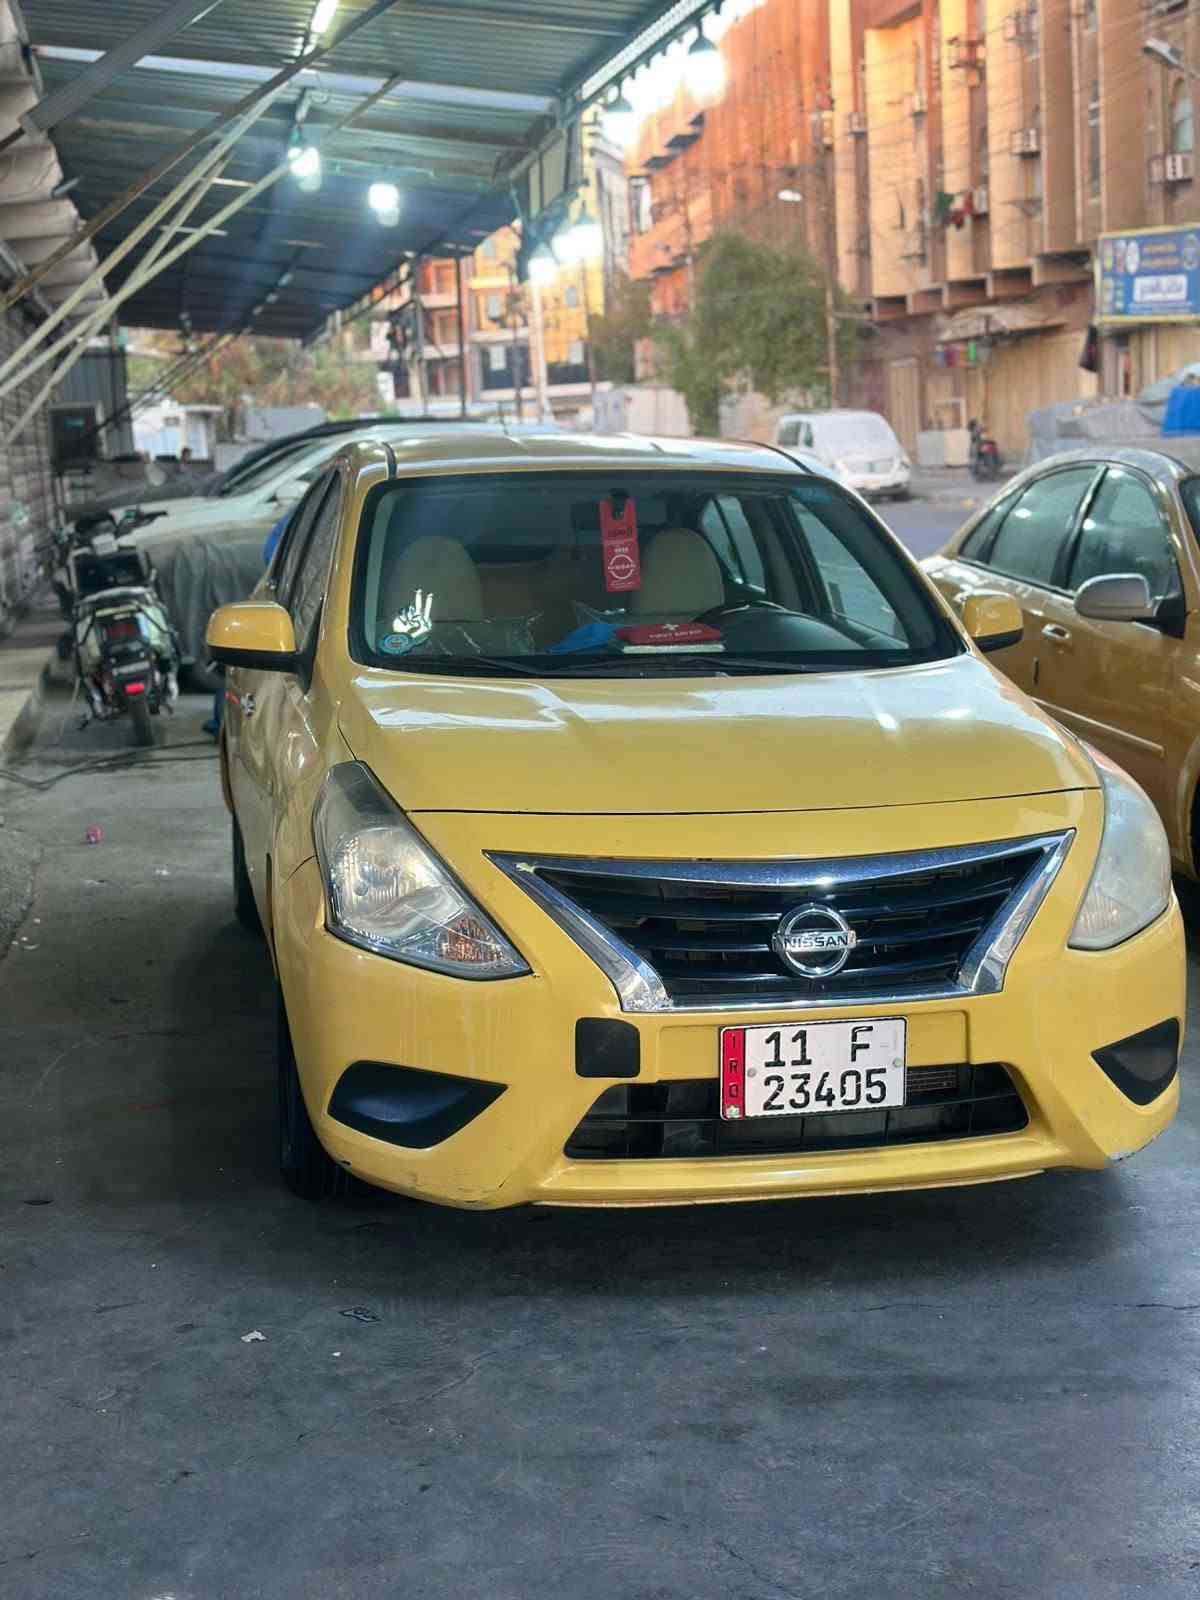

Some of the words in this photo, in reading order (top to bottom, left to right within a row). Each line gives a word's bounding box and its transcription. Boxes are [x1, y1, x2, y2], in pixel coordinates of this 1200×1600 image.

[783, 935, 848, 949] NISSAN
[764, 1029, 812, 1068] 11
[850, 1025, 874, 1062] F
[763, 1068, 887, 1111] 23405
